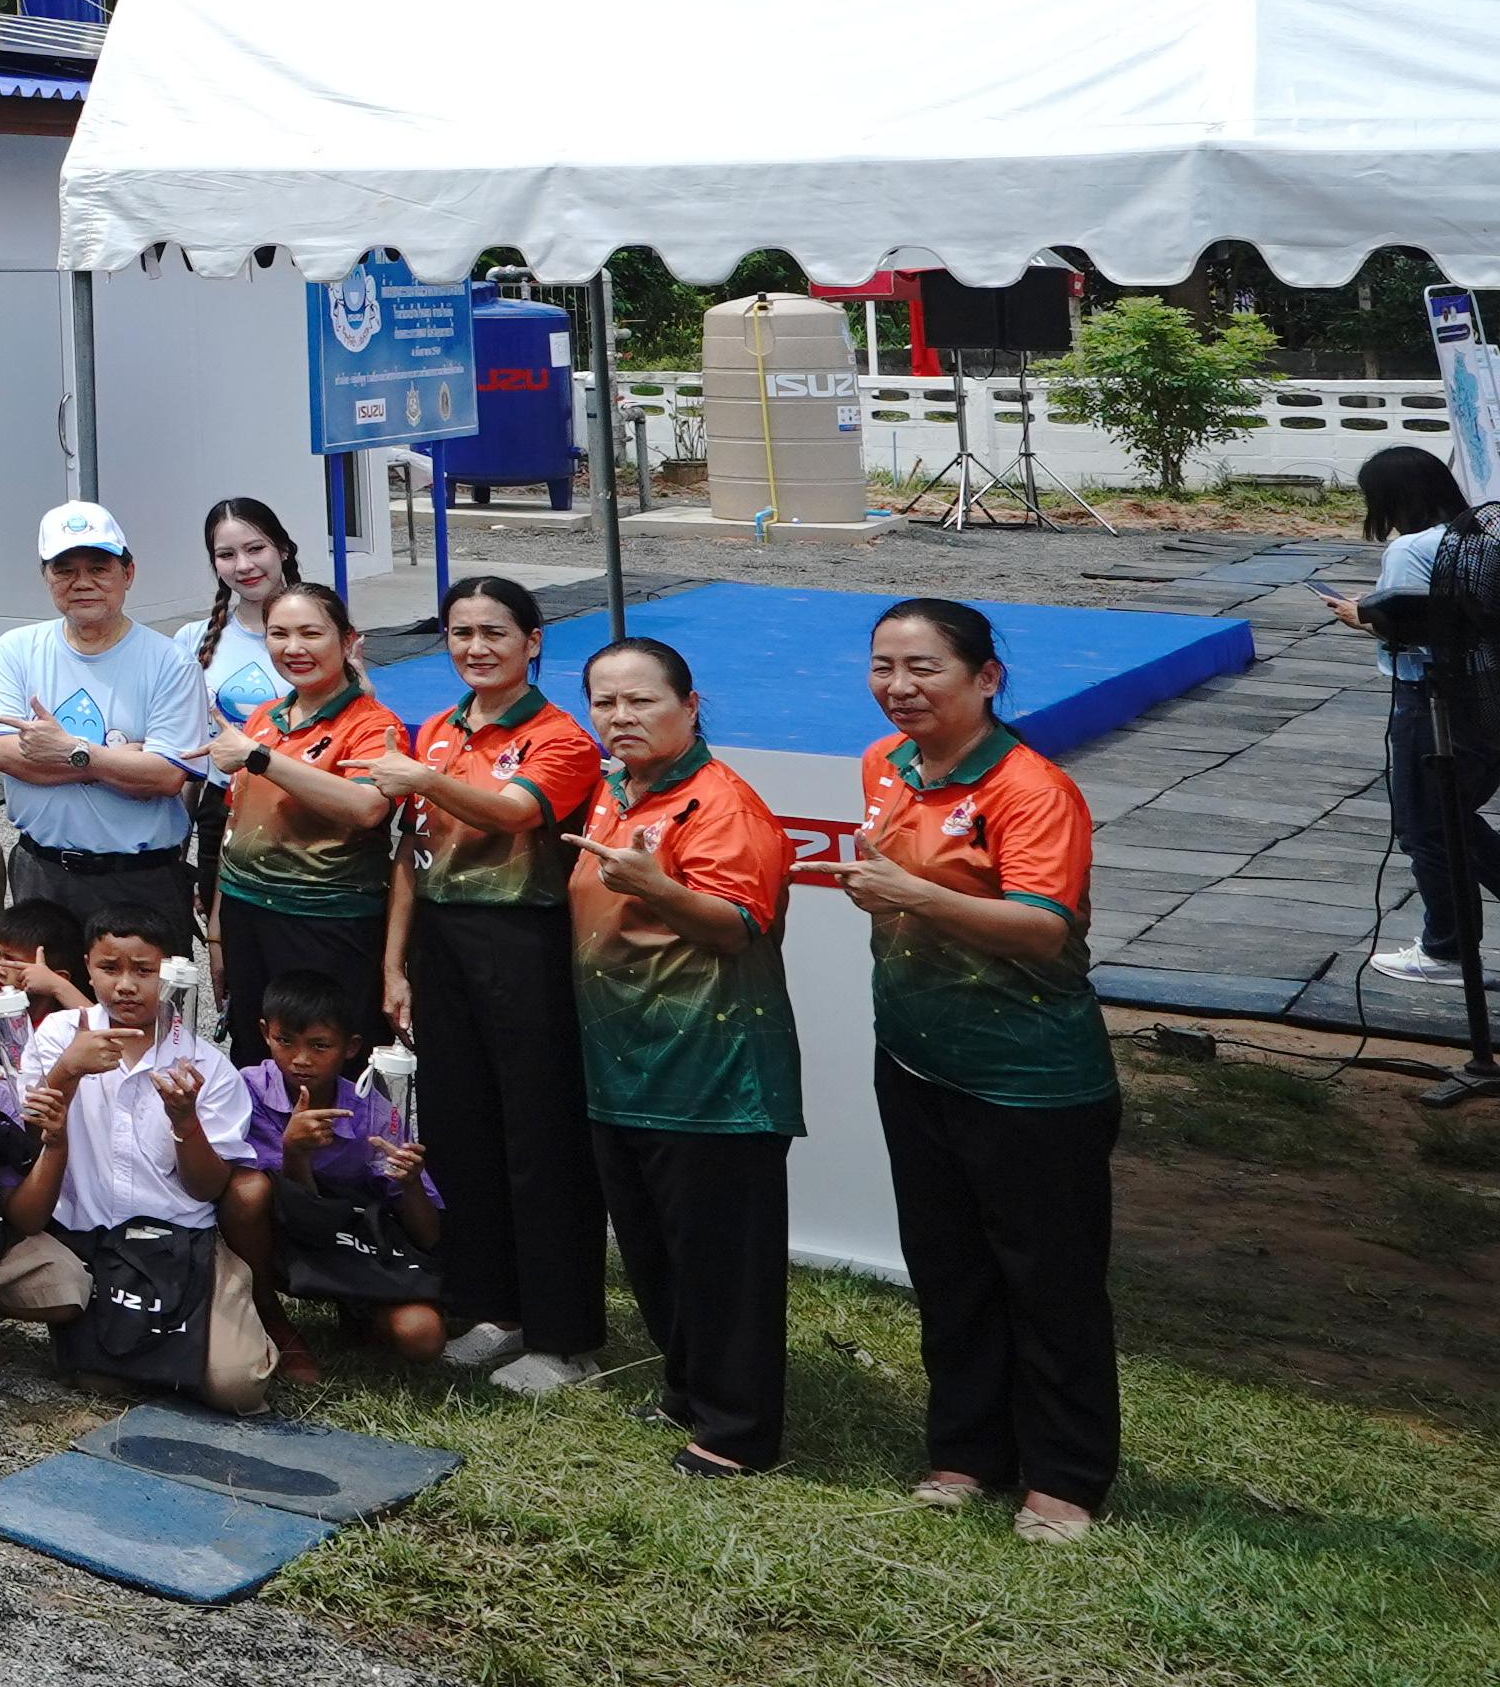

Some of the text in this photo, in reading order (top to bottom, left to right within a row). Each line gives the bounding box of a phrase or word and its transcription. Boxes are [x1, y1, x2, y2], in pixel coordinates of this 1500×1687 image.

[477, 368, 549, 391] UZU
[765, 373, 859, 397] ISUZ
[358, 403, 385, 419] ISUZU
